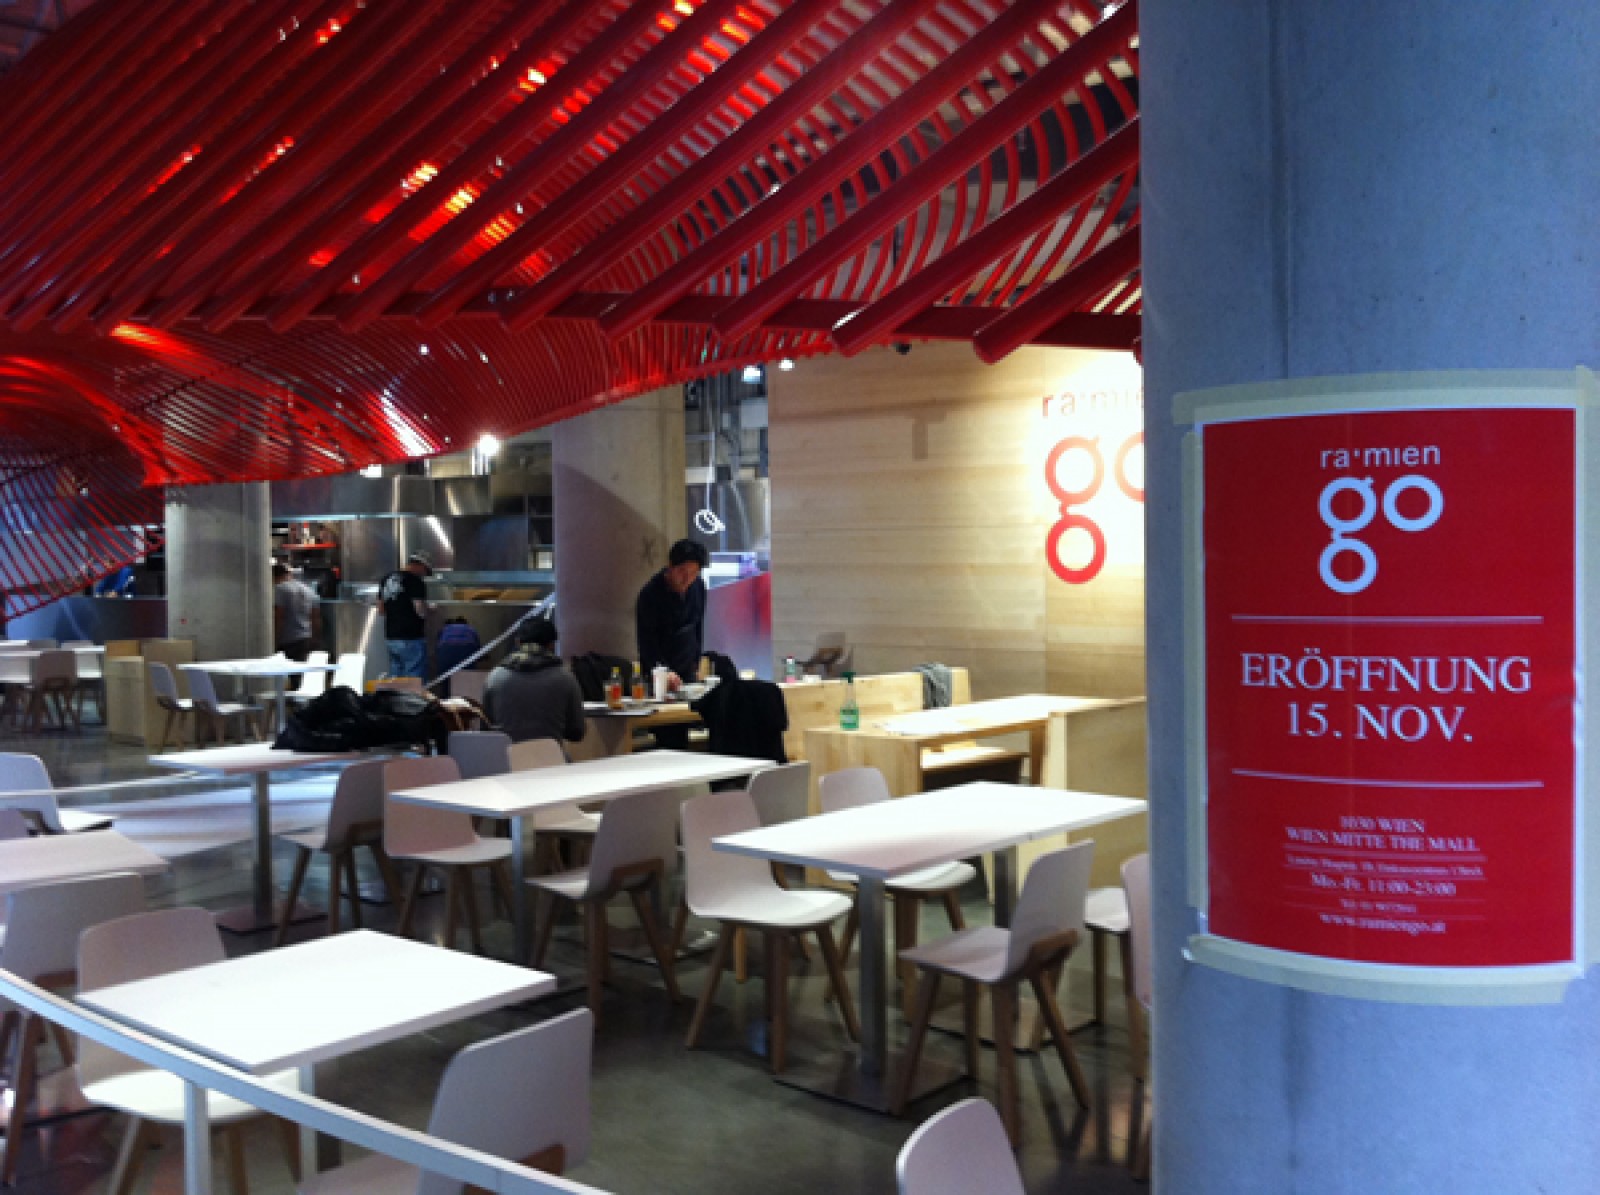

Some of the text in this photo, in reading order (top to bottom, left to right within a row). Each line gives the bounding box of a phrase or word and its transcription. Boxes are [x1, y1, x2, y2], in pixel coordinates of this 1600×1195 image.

[1318, 474, 1444, 594] go
[1240, 647, 1532, 692] ERÖFFNUNG
[1288, 702, 1473, 742] 15. NOV.
[1285, 826, 1481, 852] WIEN MITTE THE MALL
